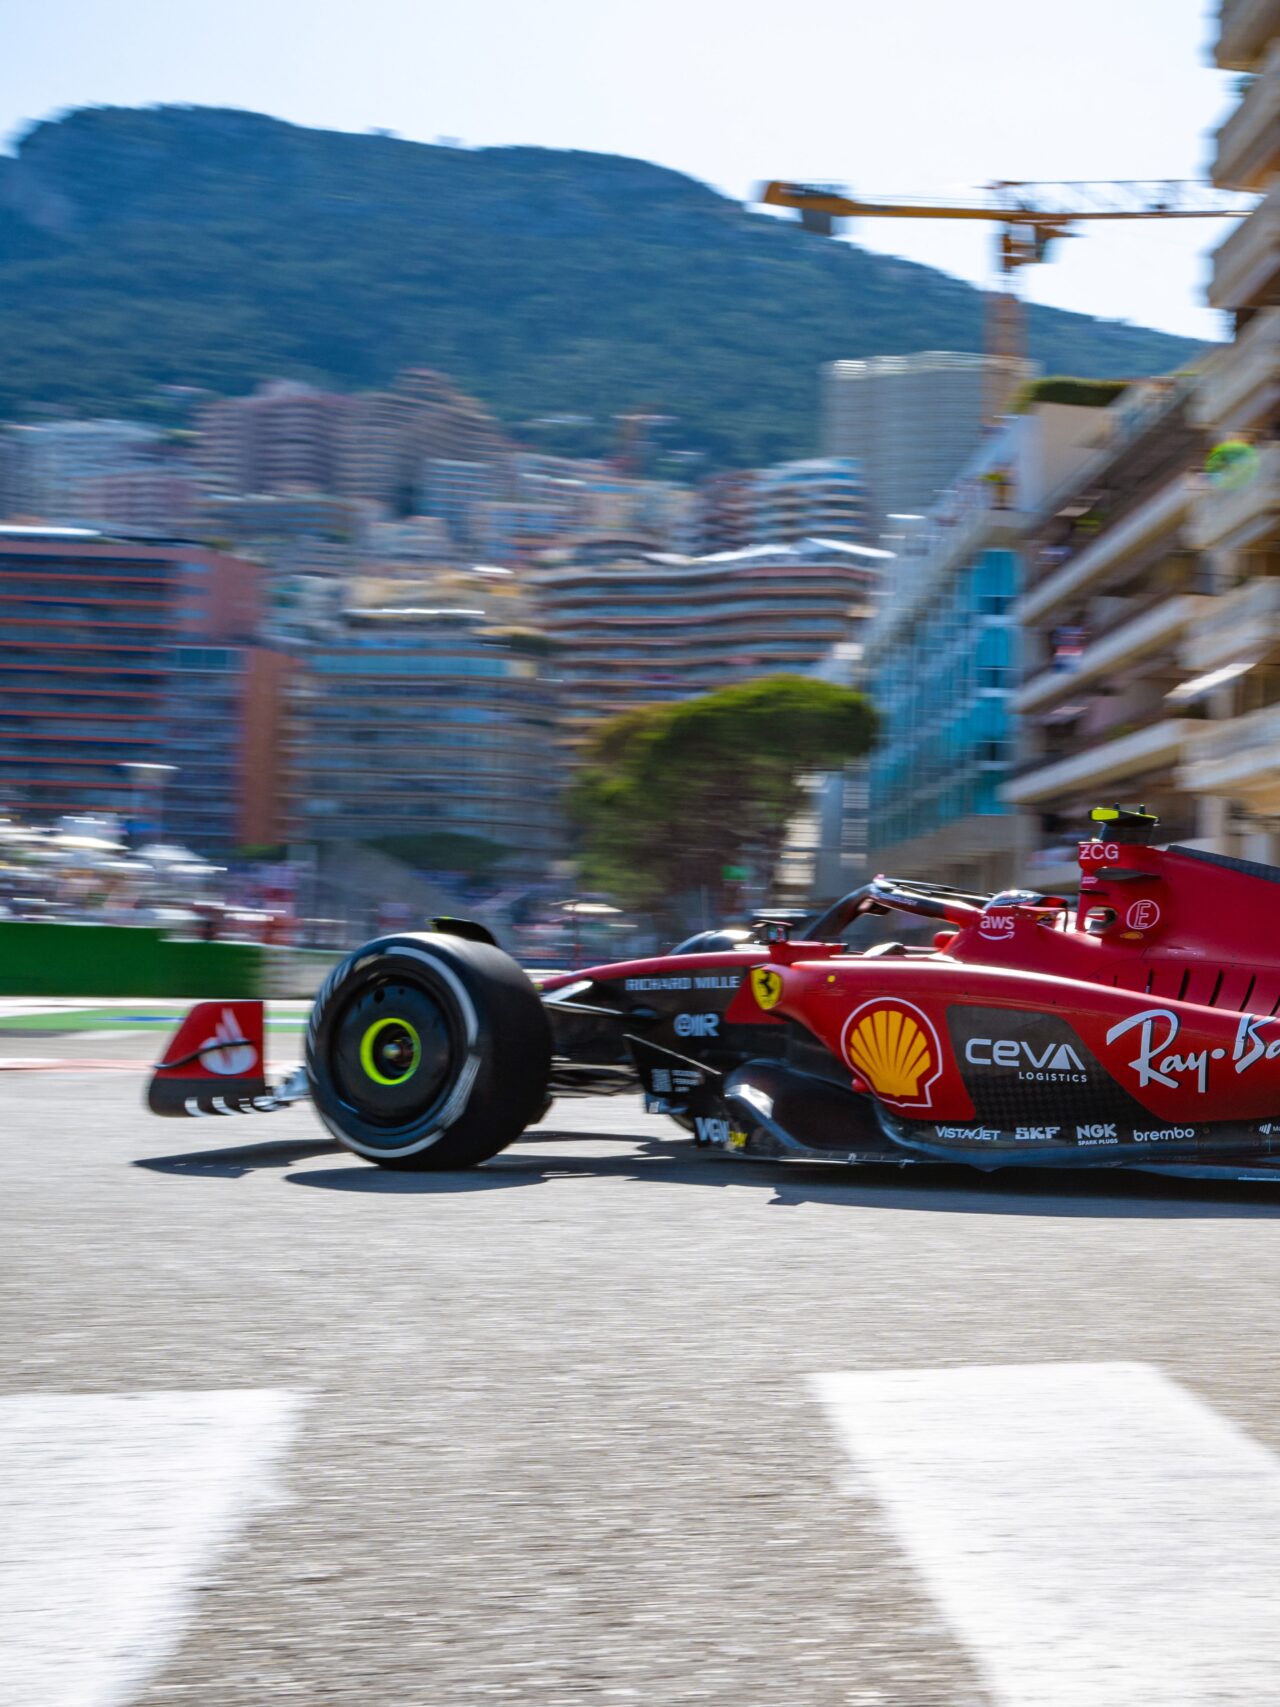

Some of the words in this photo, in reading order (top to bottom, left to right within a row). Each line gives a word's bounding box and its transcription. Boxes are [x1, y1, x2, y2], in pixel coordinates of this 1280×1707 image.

[1080, 844, 1119, 860] ZCG
[980, 915, 1015, 930] aws
[624, 978, 692, 991] RICHARD
[694, 976, 741, 989] MILLE
[965, 1037, 1086, 1071] CEVA
[1018, 1071, 1088, 1083] LOGISTICS
[1014, 1126, 1061, 1140] SKF
[1076, 1123, 1117, 1138] NGK
[1132, 1127, 1195, 1142] brembo
